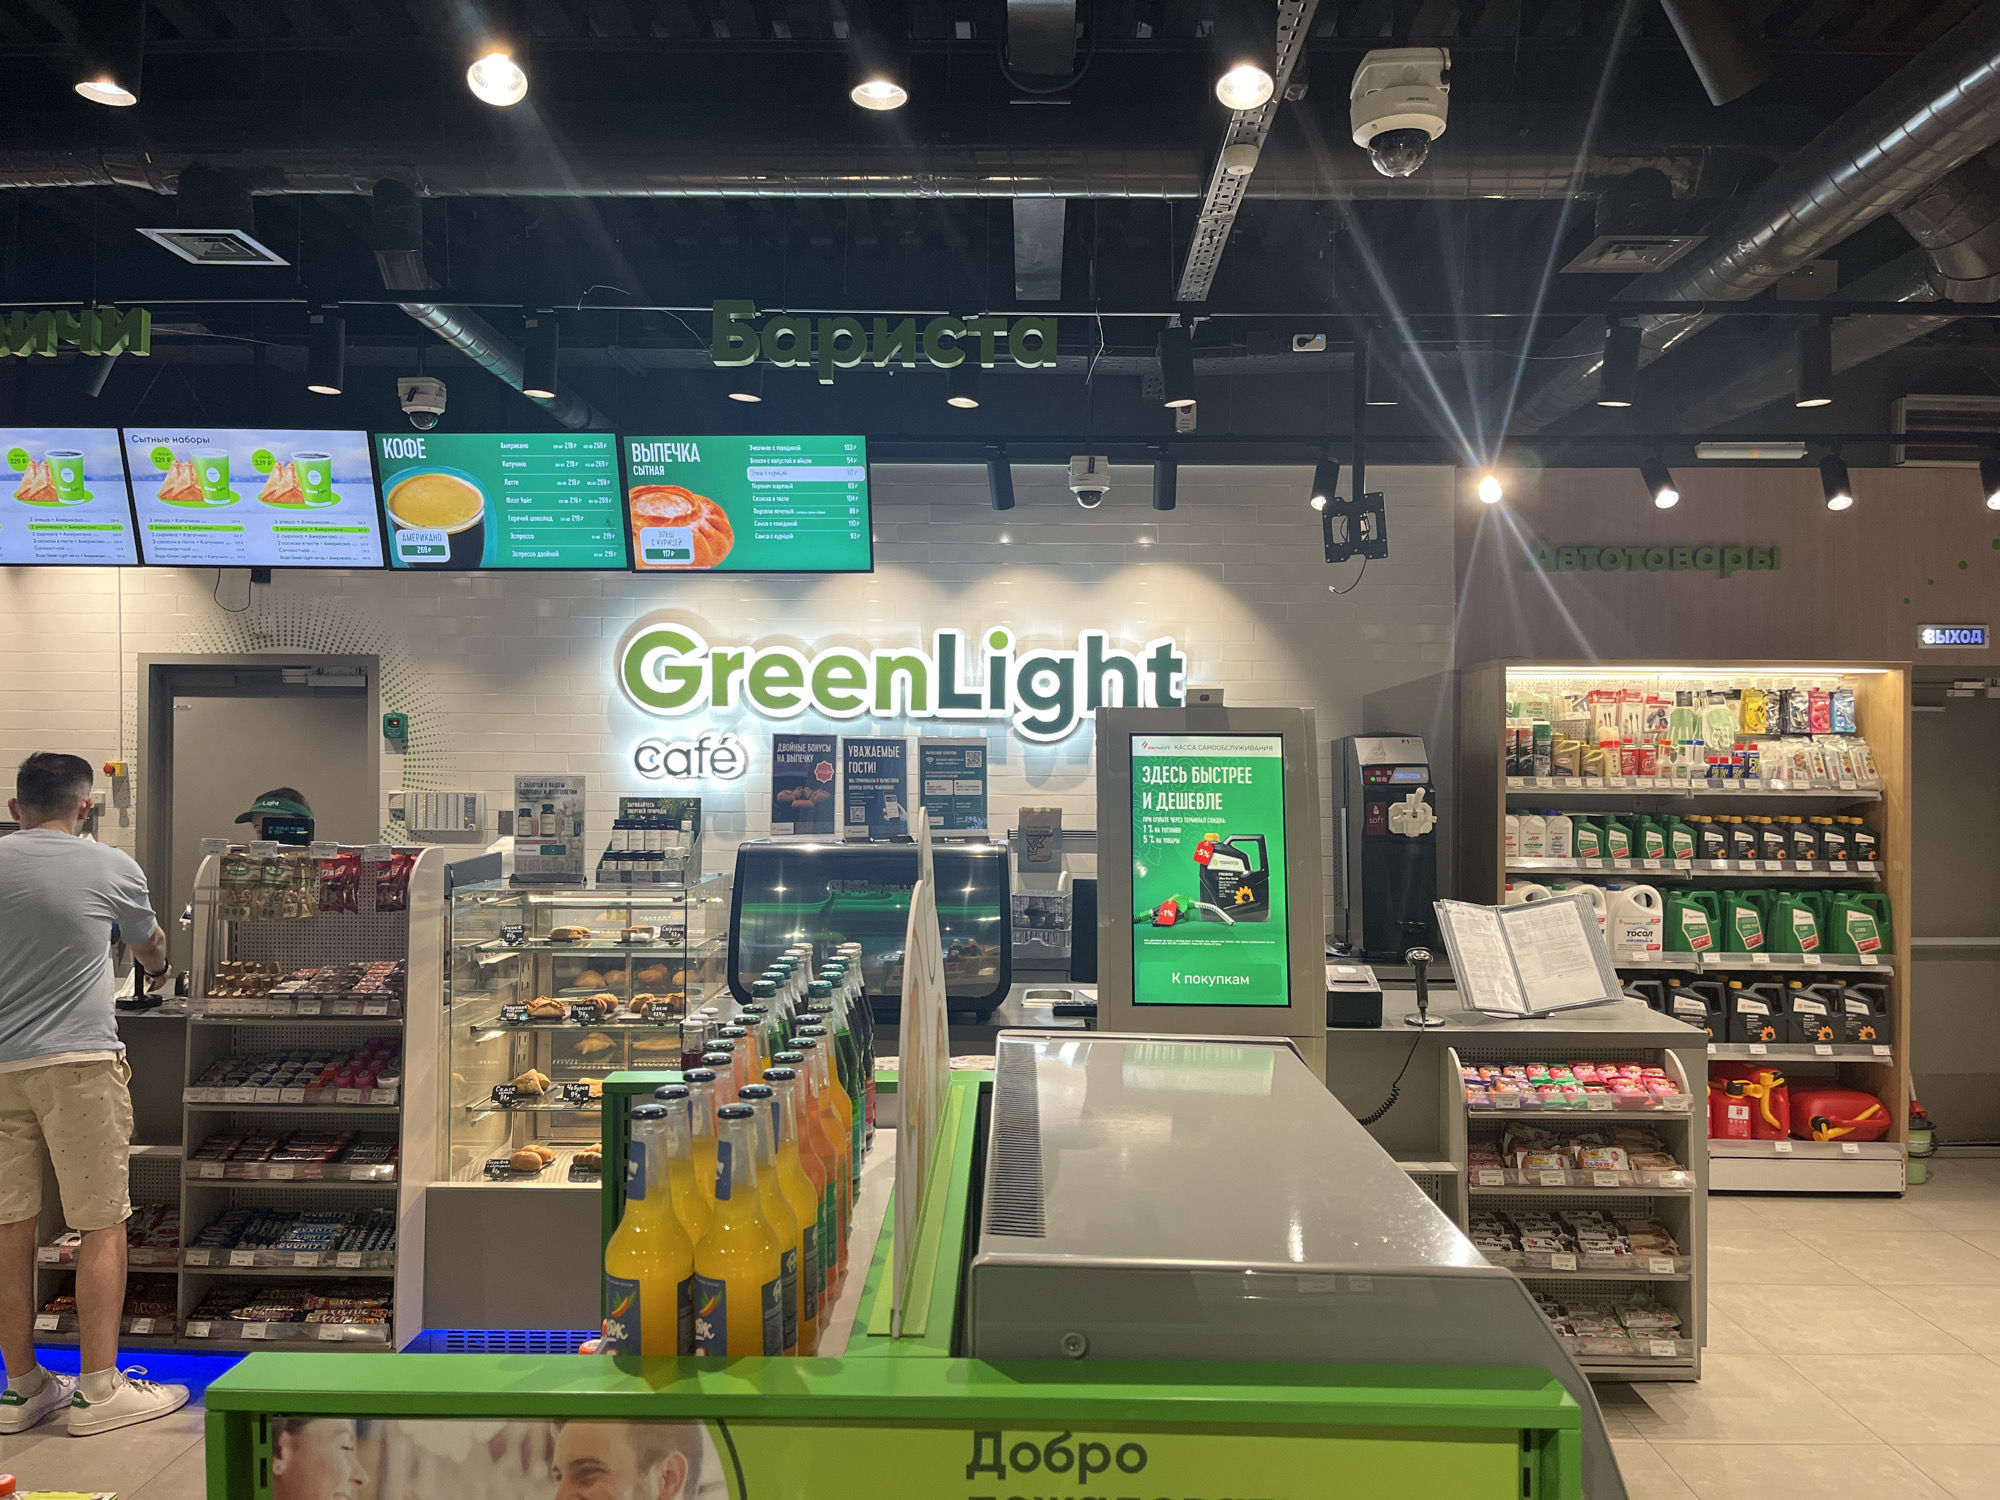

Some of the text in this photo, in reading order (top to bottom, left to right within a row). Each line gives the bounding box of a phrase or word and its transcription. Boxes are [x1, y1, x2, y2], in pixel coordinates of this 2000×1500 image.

[0, 308, 150, 357] ичи
[712, 299, 1058, 385] Бариста
[131, 434, 210, 446] Сытные наборы
[500, 442, 529, 450] Американо
[382, 438, 426, 459] КОФЕ
[632, 442, 701, 463] ВЫПЕЧКА
[633, 465, 665, 476] СЫТНАЯ
[508, 515, 529, 523] Горячий
[402, 534, 443, 542] АМЕРИКАНО
[510, 533, 535, 541] Эспрессо
[658, 531, 675, 539] ЭЛЕШ
[657, 538, 683, 547] КУРИЦЕЙ
[1524, 540, 1781, 579] Автотовары
[1922, 628, 1984, 645] ВЫХОД
[624, 630, 1186, 735] GreenLight
[777, 742, 832, 753] ДВОЙНЫЕ БОНУСЫ
[848, 745, 900, 758] УВАЖАЕМЫЕ
[634, 736, 738, 778] café
[777, 754, 814, 763] НА ВЫПЕЧКУ
[848, 762, 877, 774] ГОСТИ!
[1142, 766, 1253, 785] ЗДЕСЬ БЫСТРЕЕ
[1143, 792, 1223, 812] И ДЕШЕВЛЕ
[1369, 816, 1384, 824] soft
[1196, 849, 1210, 858] -5%
[1172, 972, 1250, 988] К покупкам
[966, 1430, 1149, 1485] Добро
